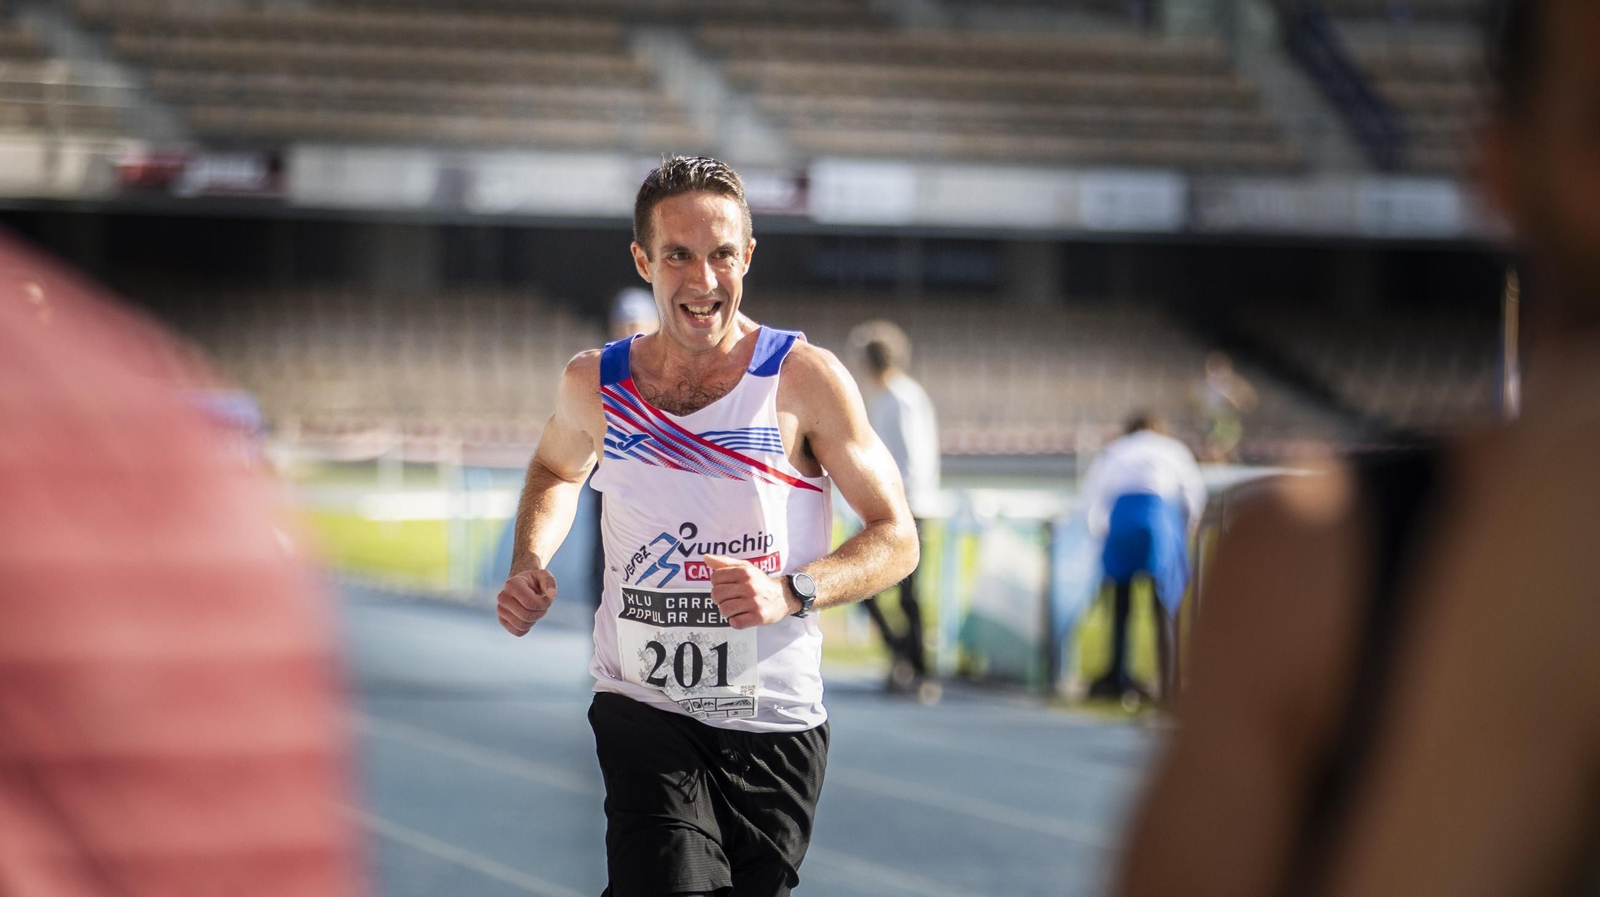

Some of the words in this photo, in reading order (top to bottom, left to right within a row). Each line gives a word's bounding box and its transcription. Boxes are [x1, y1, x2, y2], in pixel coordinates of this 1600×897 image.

[666, 597, 719, 609] CARR
[626, 607, 688, 624] POPULAR
[696, 612, 728, 624] JER
[645, 640, 734, 688] 201
